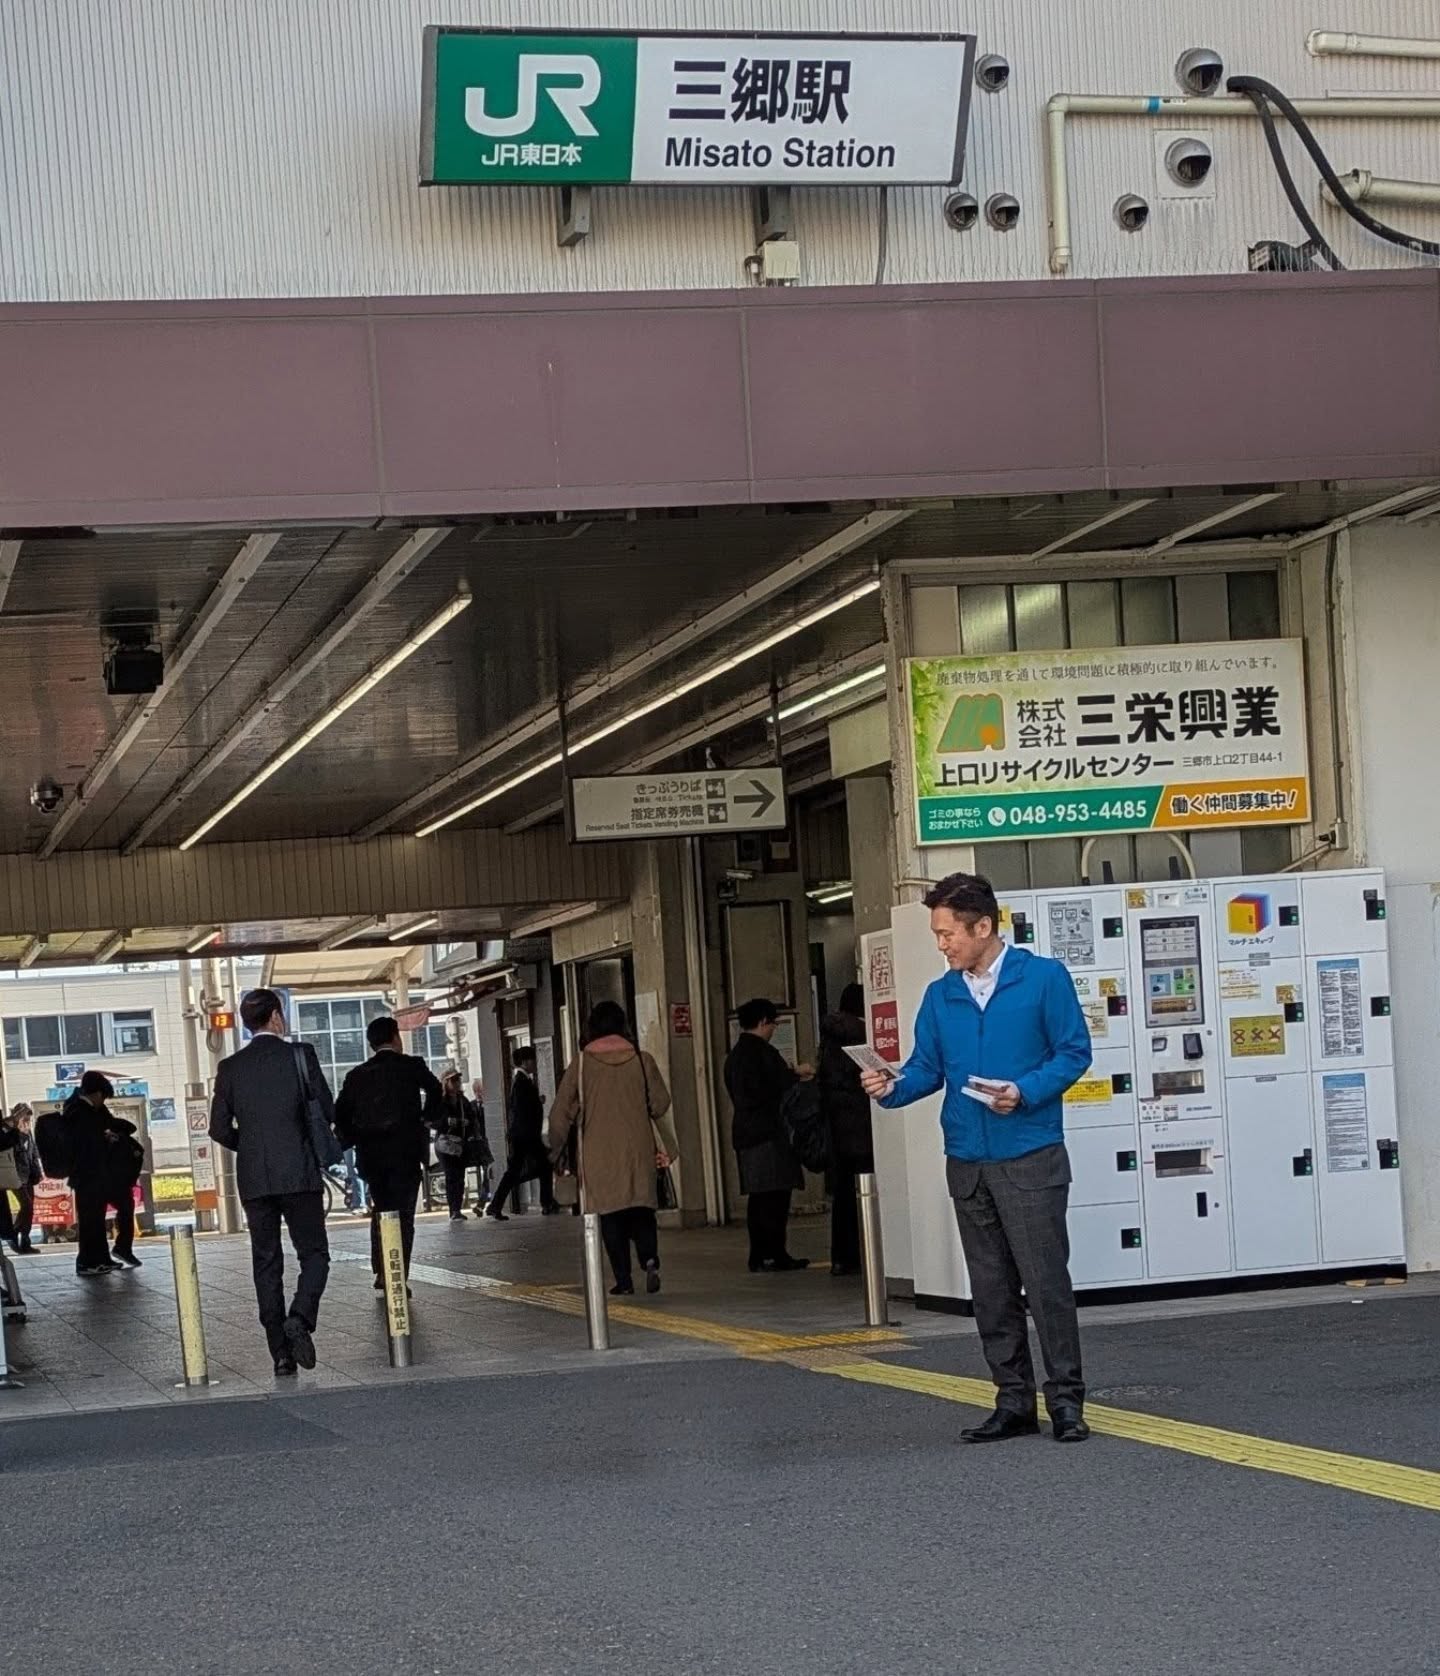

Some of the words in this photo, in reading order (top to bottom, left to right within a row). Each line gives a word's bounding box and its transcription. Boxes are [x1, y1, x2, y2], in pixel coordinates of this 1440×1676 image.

[464, 54, 601, 137] JR
[668, 57, 852, 125] 三郷駅
[481, 143, 582, 167] JR東日本
[665, 137, 772, 168] Misato
[782, 138, 896, 169] Station
[1017, 698, 1066, 723] 株式
[1076, 686, 1282, 747] 三栄興業
[1018, 723, 1067, 748] 会社
[934, 752, 1175, 788] 上口リサイクルセンター
[1182, 752, 1284, 768] 三郷市上口2丁目44-1
[636, 779, 702, 795] きっぷうりば
[631, 804, 704, 821] 指定席券売機
[928, 807, 981, 819] ゴミの事なら
[1009, 800, 1148, 825] 048-953-4485
[1171, 790, 1297, 815] 働く仲間募集中!
